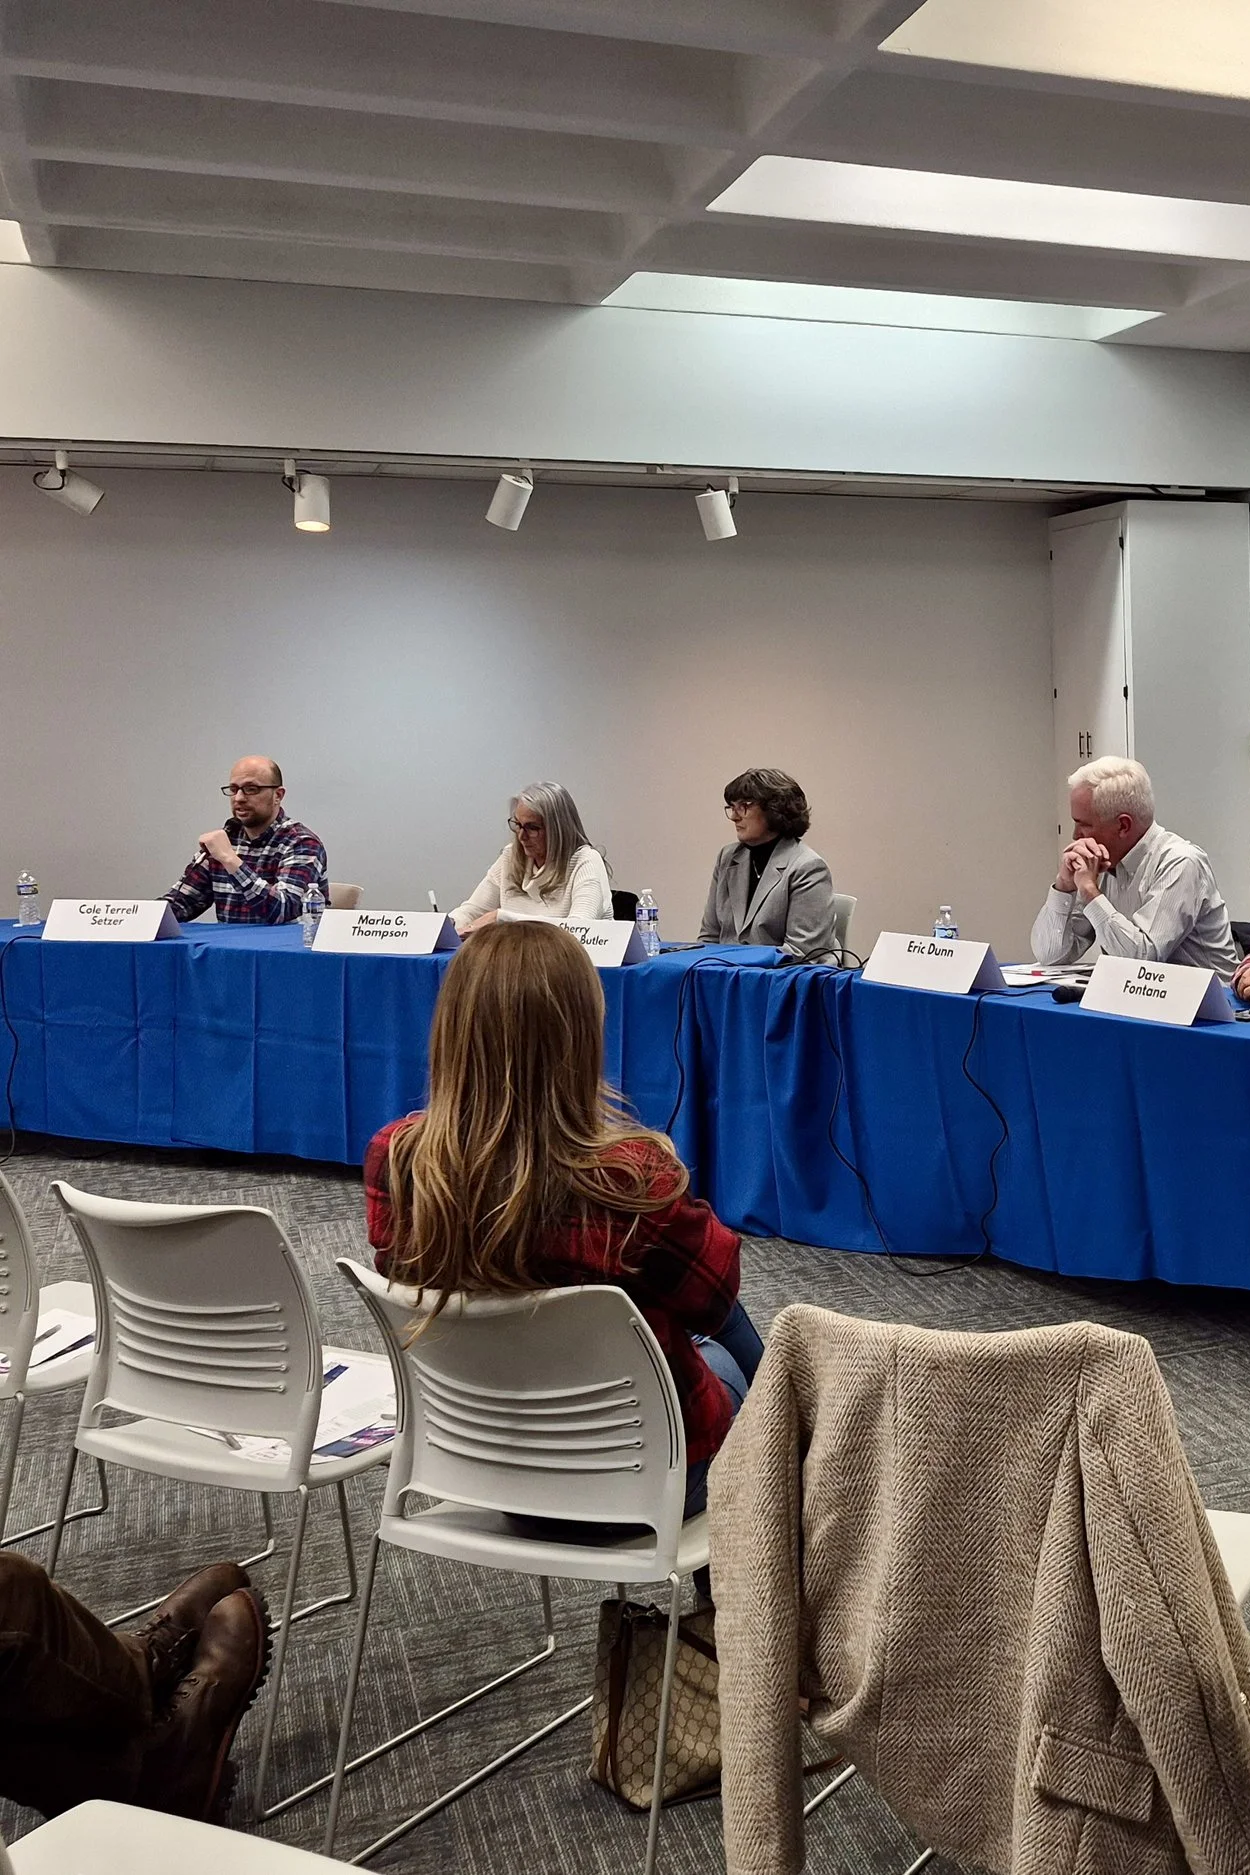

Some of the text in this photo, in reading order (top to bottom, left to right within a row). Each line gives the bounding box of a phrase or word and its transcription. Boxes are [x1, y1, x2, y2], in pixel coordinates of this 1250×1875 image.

[79, 904, 139, 914] Cole Terrell
[91, 915, 124, 926] Setzer
[357, 914, 407, 926] Marla G.
[351, 926, 409, 940] Thompson
[580, 935, 608, 946] Butler
[907, 940, 954, 957] Eric Dunn
[1137, 966, 1165, 983] Dave
[1123, 979, 1167, 999] Fontana
